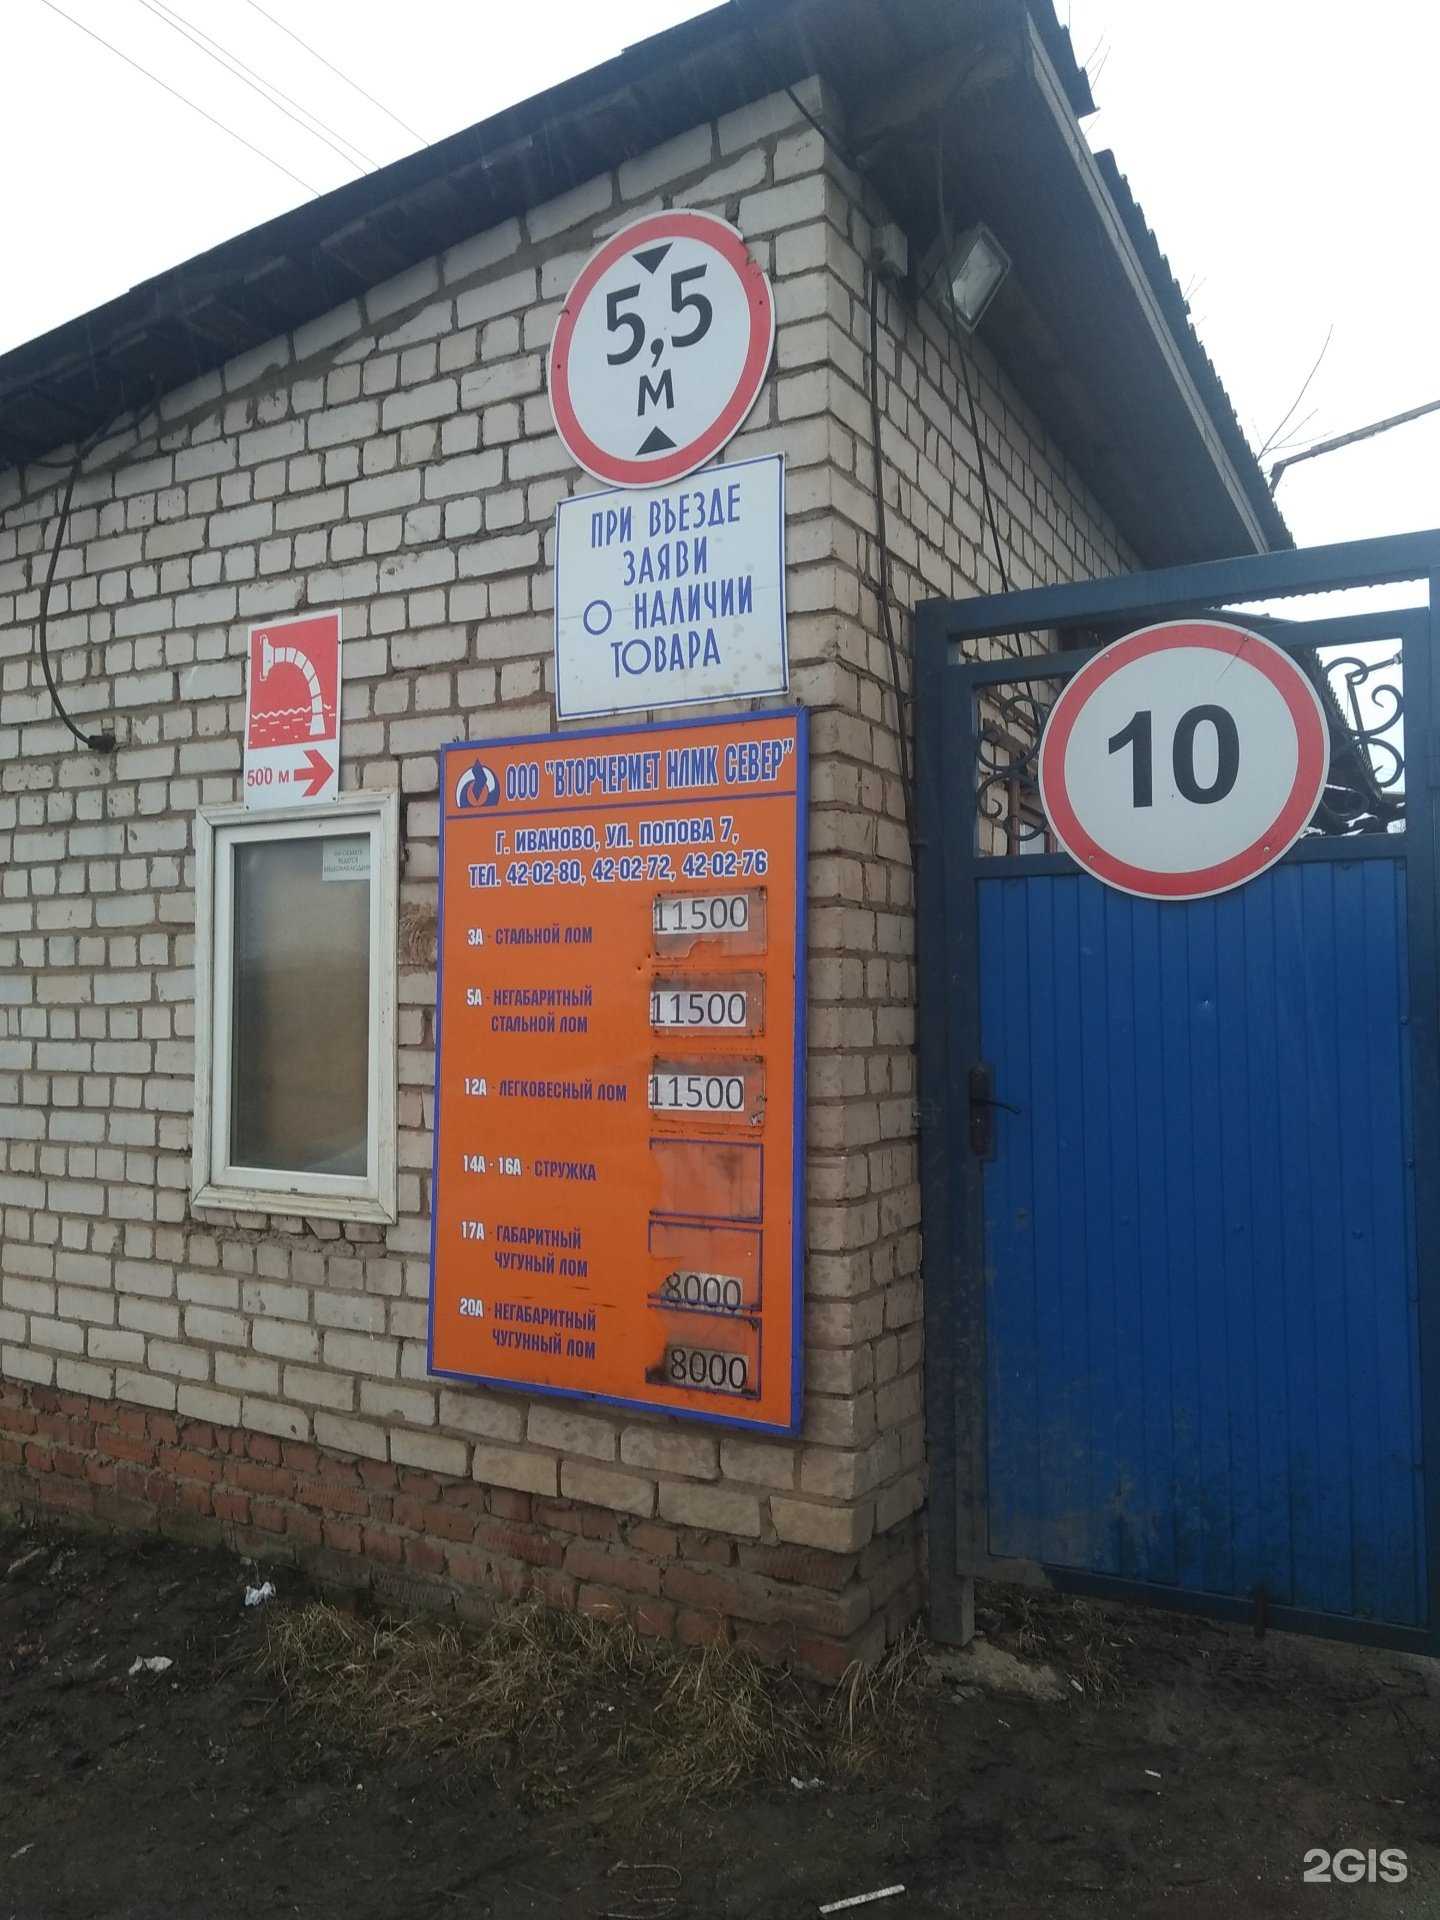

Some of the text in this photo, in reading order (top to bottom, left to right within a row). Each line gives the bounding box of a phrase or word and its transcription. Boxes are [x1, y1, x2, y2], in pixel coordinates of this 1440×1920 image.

[606, 263, 712, 368] 5,5
[591, 483, 741, 548] ПРИ ВЪЕЗДЕ
[623, 536, 707, 586] ЗАЯВИ
[583, 575, 753, 635] О НАЛИЧИИ
[610, 628, 721, 678] ТОВАРА
[506, 762, 539, 800] ООО
[666, 745, 719, 789] НЛМК
[1108, 704, 1240, 808] 10
[247, 767, 273, 787] 500
[496, 816, 739, 855] Г. ИВАНОВО, УЛ. ПОПОВА 7,
[468, 849, 768, 887] ТЕЛ. 42-02-80, 42-02-72, 42-02-76
[654, 896, 748, 931] 11500
[468, 922, 592, 945] 3А СТАЛЬНОЙ ЛОМ
[467, 985, 592, 1006] 5А НЕГАБАРИТНЫЙ
[651, 993, 746, 1025] 11500
[491, 1012, 588, 1032] СТАЛЬНОЙ ЛОМ
[464, 1077, 627, 1101] 12А ЛЕГКОВЕСНЫЙ ЛОМ
[649, 1076, 744, 1109] 11500
[463, 1155, 597, 1181] 14А 16А СТРУЖКА
[461, 1220, 581, 1249] 17А ГАБАРИТНЫЙ
[494, 1251, 587, 1277] ЧУГУНЫЙ ЛОМ
[666, 1271, 742, 1310] 8000
[459, 1297, 596, 1331] 20А НЕГАБАРИТНЫЙ
[492, 1328, 595, 1360] ЧУГУННЫЙ ЛОМ
[671, 1348, 747, 1389] 8000
